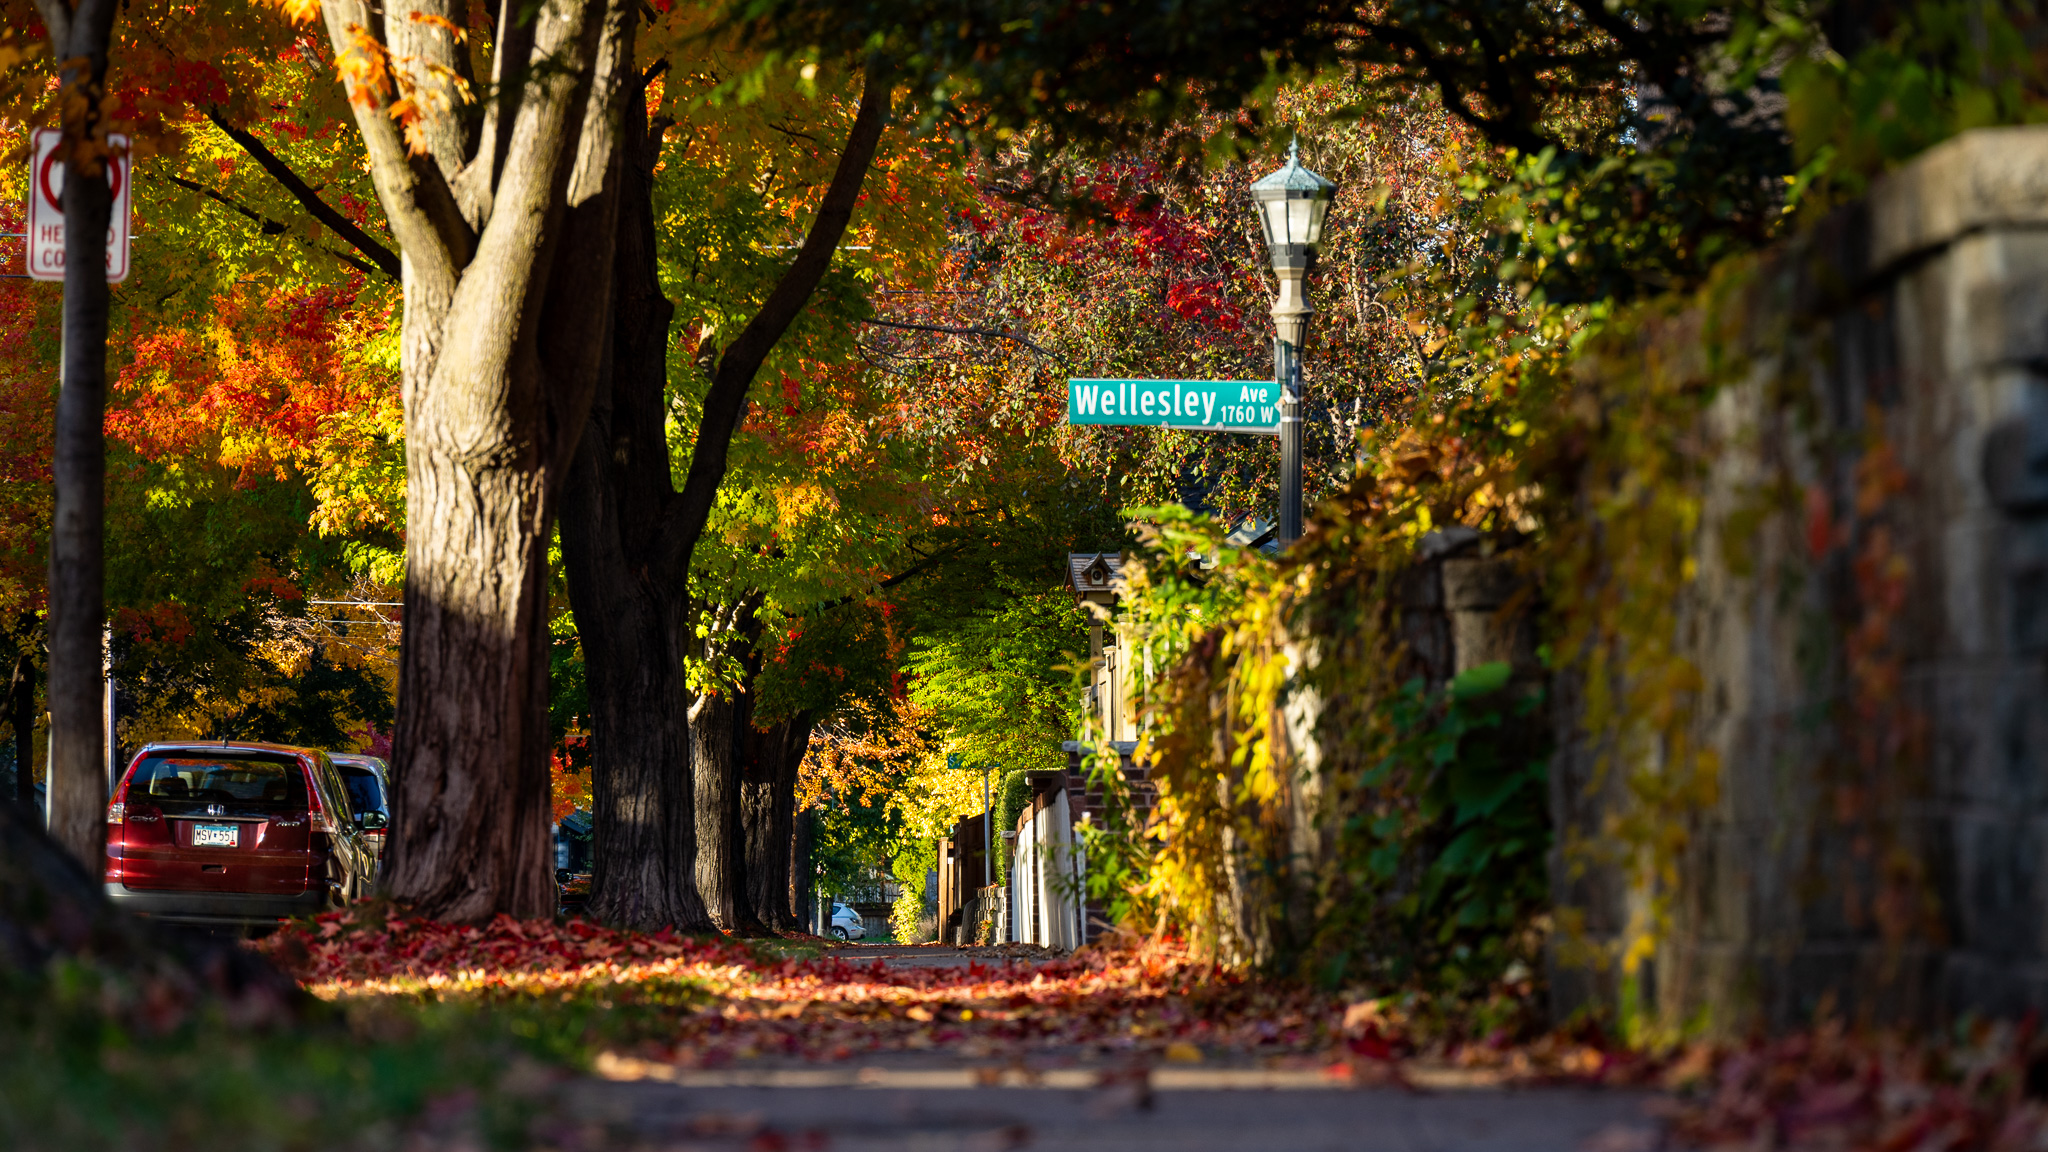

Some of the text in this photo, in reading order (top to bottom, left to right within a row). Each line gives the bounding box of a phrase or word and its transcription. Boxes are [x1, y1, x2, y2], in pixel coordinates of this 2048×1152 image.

[1075, 383, 1268, 425] Wellesley Ave
[1220, 405, 1274, 423] 1760 W
[195, 829, 235, 842] MSV 551
